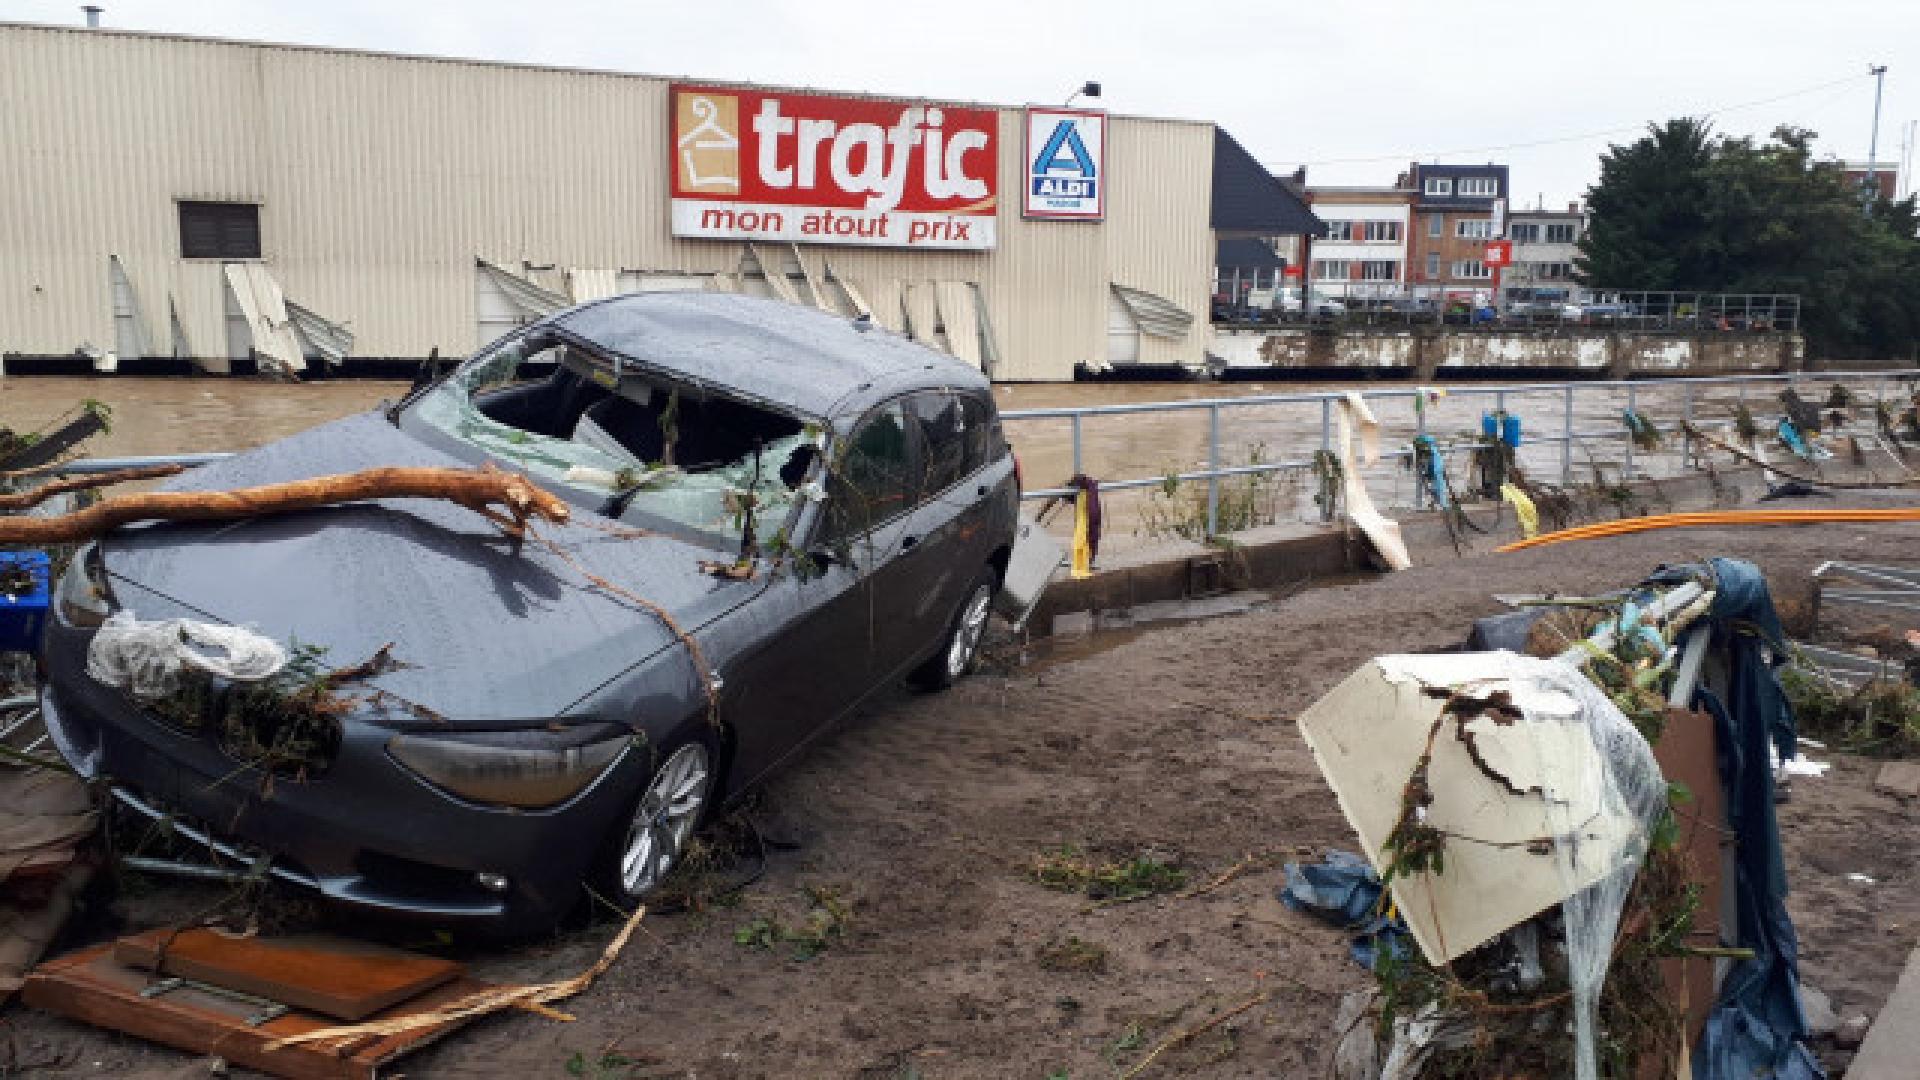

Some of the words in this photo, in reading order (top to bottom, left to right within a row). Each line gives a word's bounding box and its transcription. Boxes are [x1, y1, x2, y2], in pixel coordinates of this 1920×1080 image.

[752, 98, 990, 213] trafic
[1039, 179, 1090, 196] ALDI
[700, 207, 784, 234] mon
[801, 210, 889, 239] atout
[908, 214, 971, 243] prix
